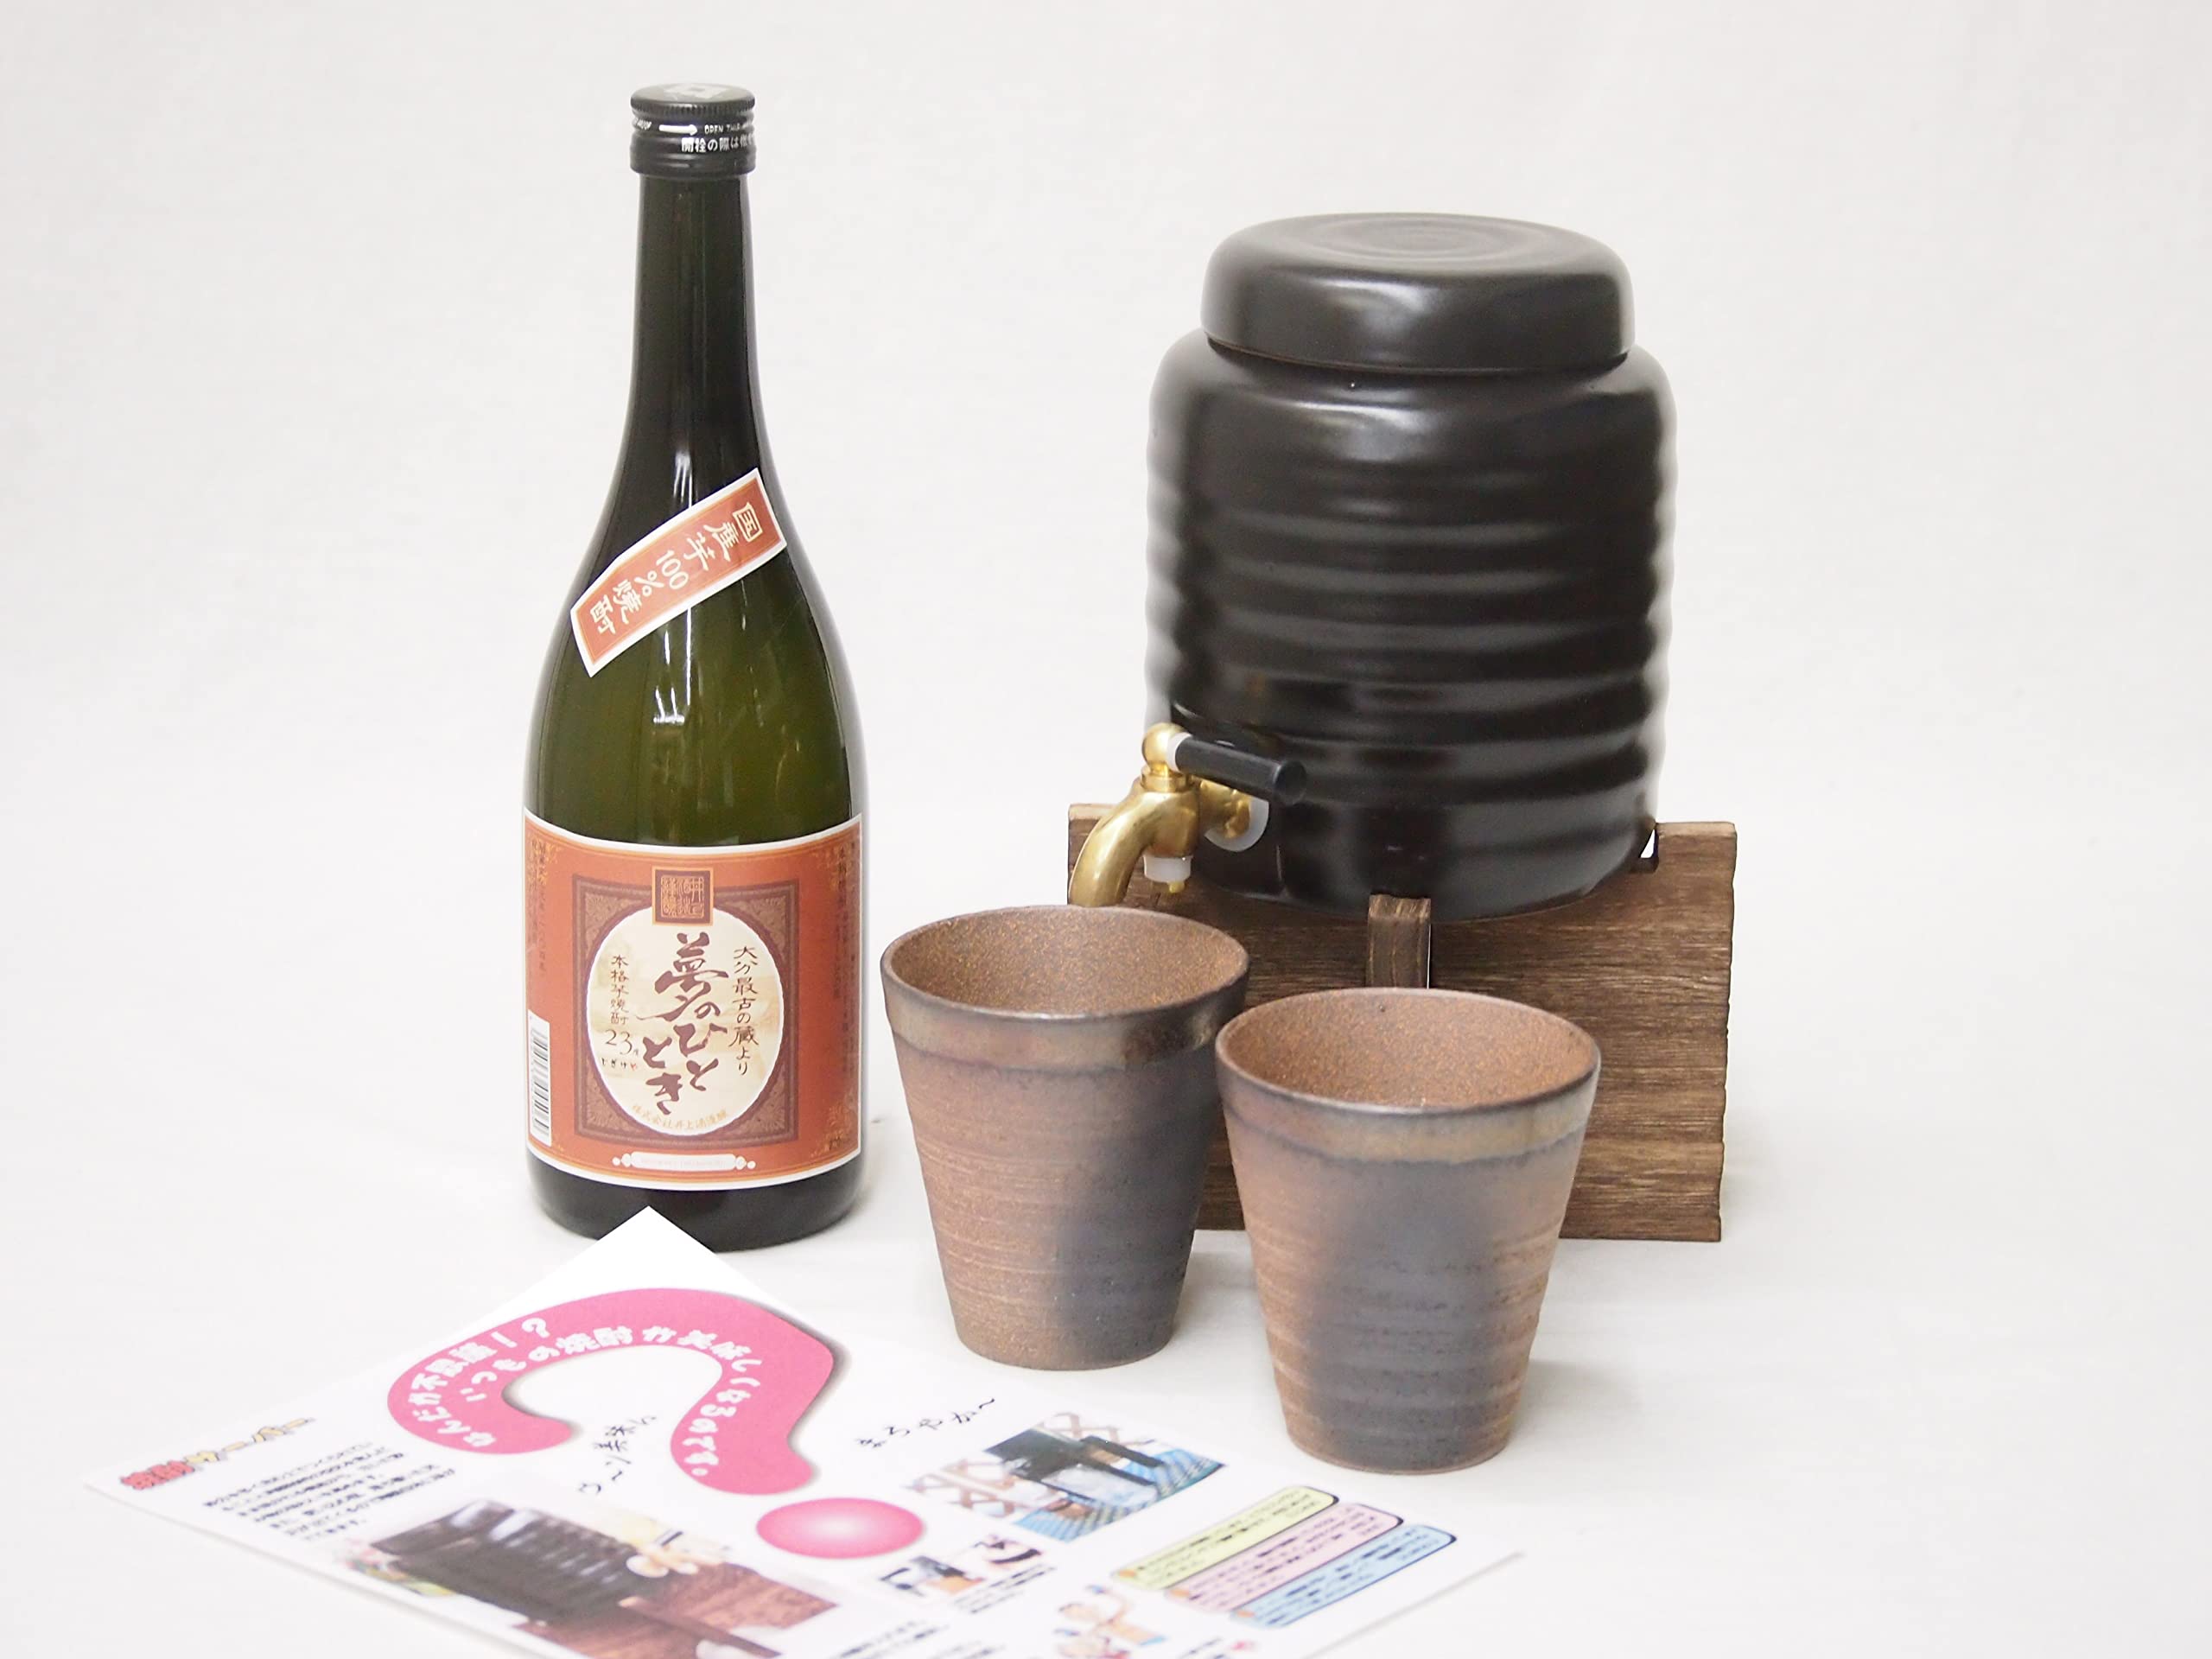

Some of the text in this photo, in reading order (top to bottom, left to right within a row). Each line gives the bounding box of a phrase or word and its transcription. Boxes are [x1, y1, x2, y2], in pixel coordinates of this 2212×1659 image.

[728, 945, 759, 1076] 大分最古の蔵より
